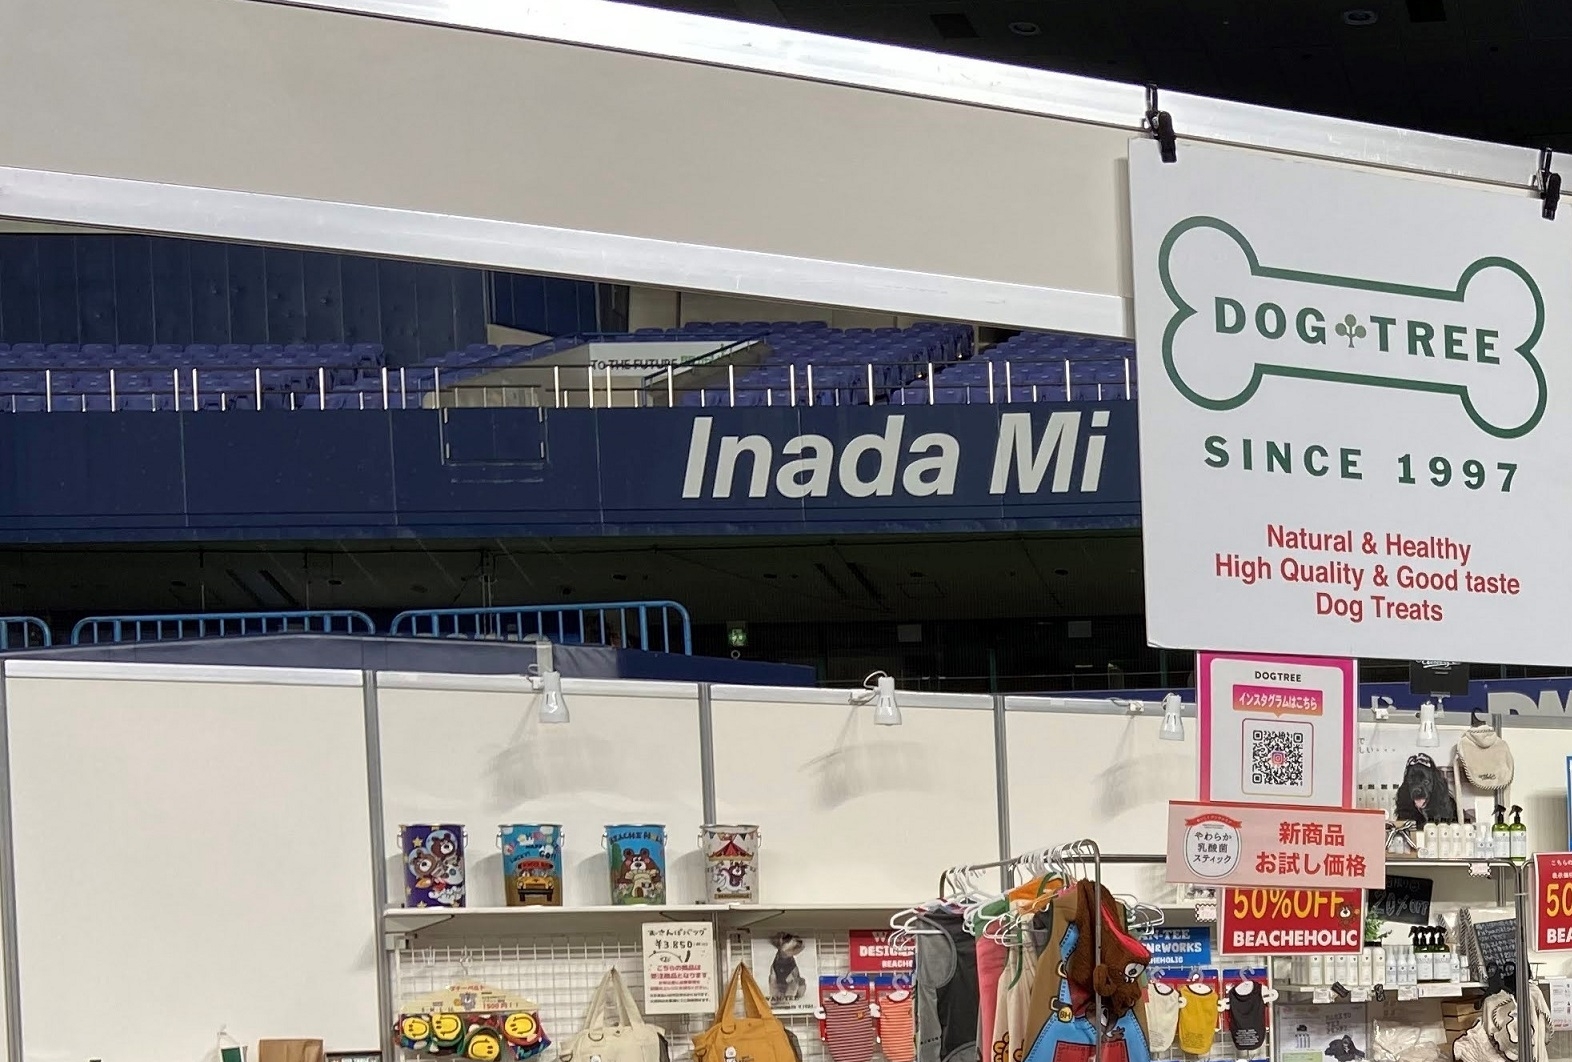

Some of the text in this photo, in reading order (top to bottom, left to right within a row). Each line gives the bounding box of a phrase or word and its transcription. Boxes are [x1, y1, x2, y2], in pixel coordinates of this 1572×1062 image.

[1214, 297, 1500, 364] DOG TREE
[683, 414, 960, 499] Inada
[1204, 436, 1517, 492] SINCE 1997
[1267, 525, 1471, 566] Natural & Healthy
[1215, 554, 1520, 595] High Quality & Good taste
[1316, 592, 1443, 622] Dog Treats
[1255, 670, 1302, 682] DOGTREE
[1238, 692, 1318, 710] インスタグラムはこちら
[1194, 831, 1232, 842] やわらか
[1279, 822, 1345, 846] 新商品
[1192, 854, 1232, 864] スティック
[1198, 842, 1228, 854] 乳酸菌
[1256, 851, 1366, 877] お試し価格
[1233, 888, 1344, 920] 50%OFF
[1233, 930, 1358, 947] BEACHEHOLIC
